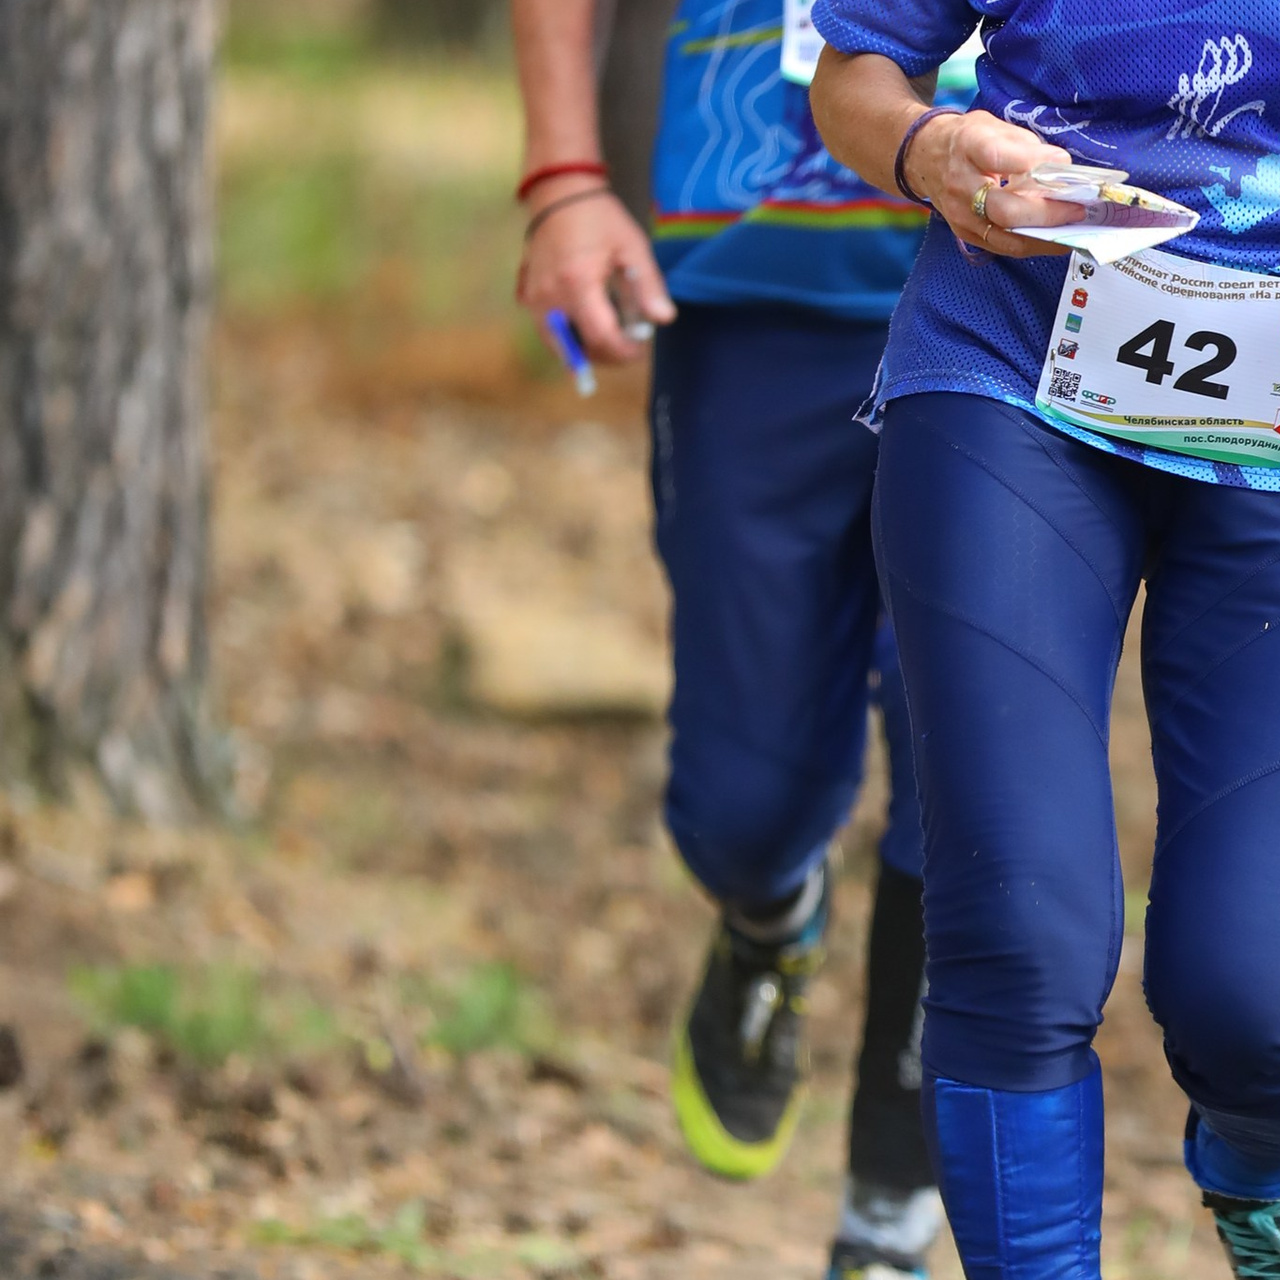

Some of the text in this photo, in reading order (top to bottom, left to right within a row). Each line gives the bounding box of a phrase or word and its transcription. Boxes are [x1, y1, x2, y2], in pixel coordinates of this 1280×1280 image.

[1171, 274, 1214, 288] России
[1218, 281, 1255, 289] среди
[1161, 284, 1246, 300] соревнования
[1116, 319, 1237, 400] 42
[1124, 416, 1244, 426] Челябинская область
